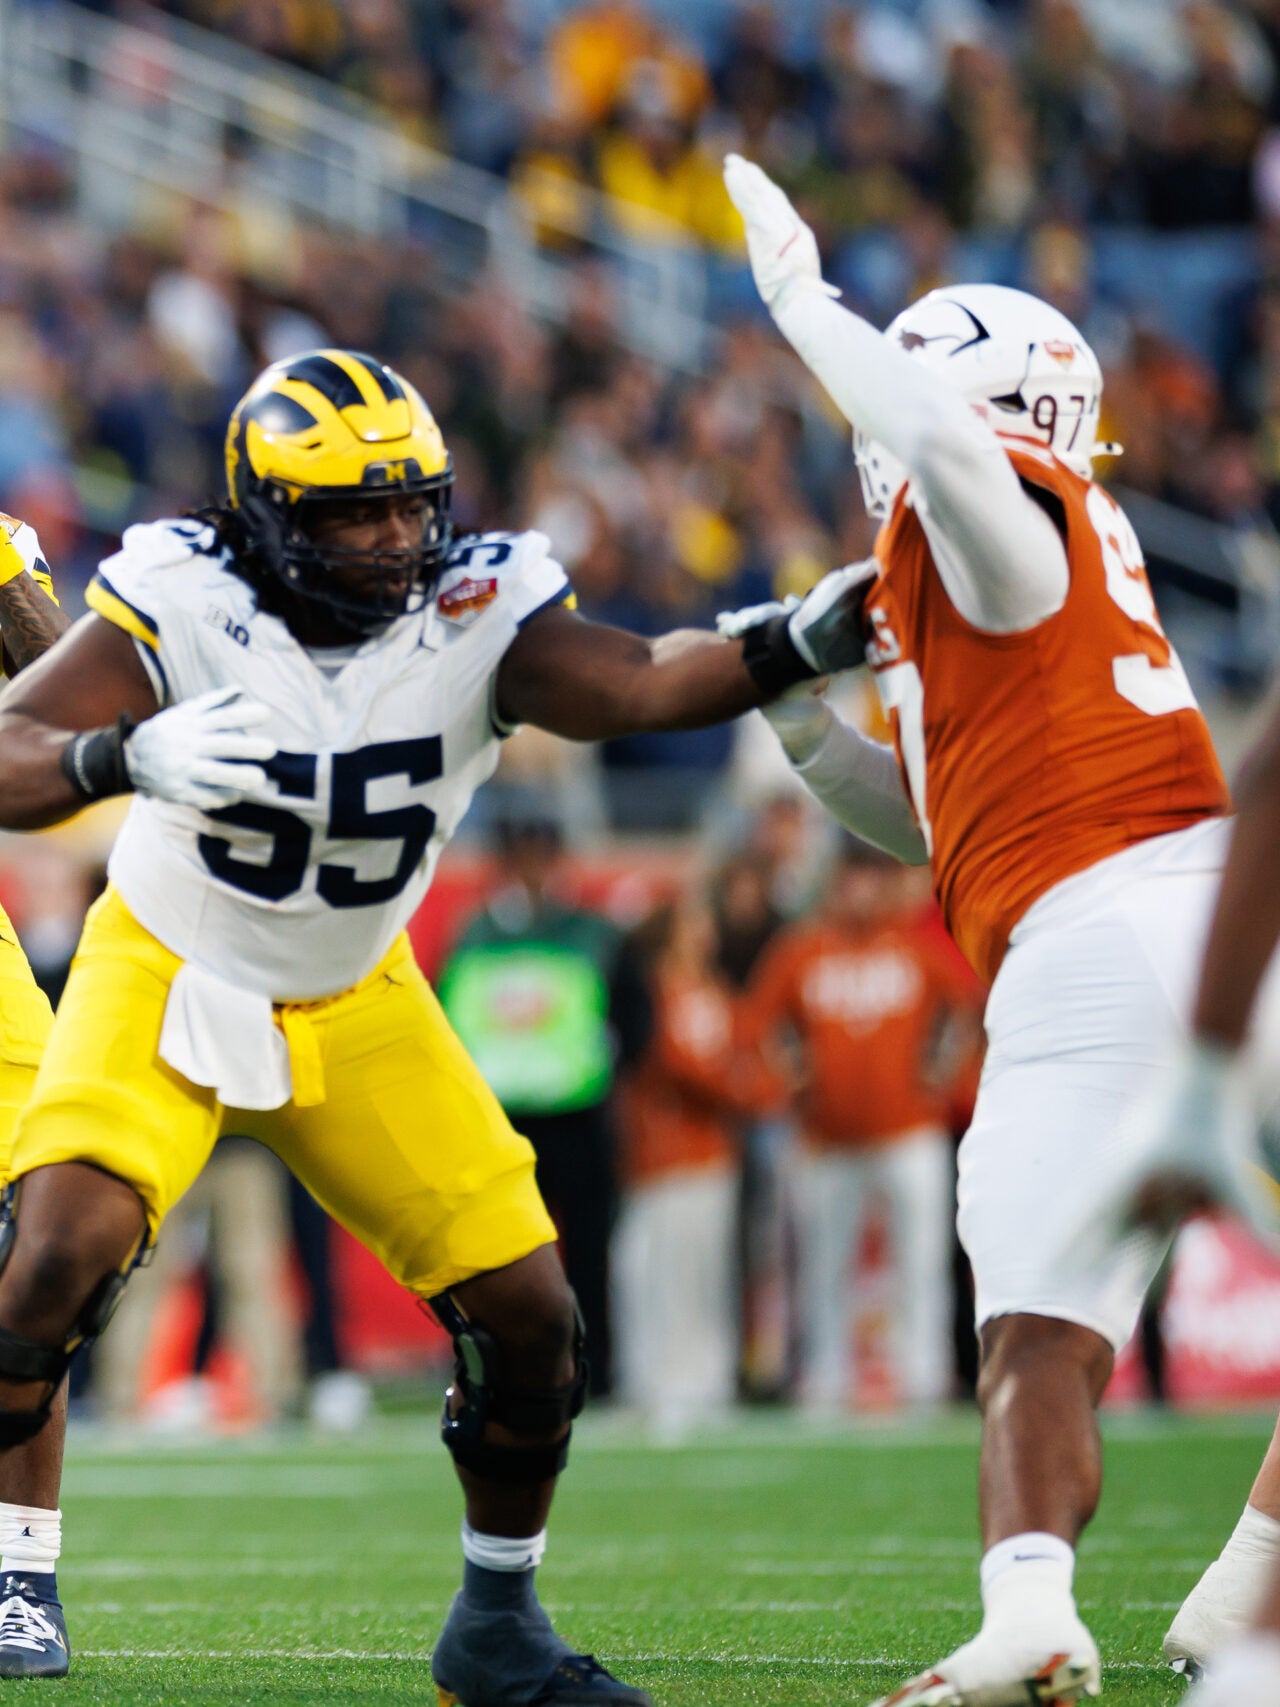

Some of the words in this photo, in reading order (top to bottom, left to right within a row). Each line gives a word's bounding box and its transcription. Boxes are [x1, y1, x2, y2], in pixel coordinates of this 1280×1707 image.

[1032, 394, 1086, 453] 97
[385, 461, 407, 482] M
[198, 734, 444, 908] 55
